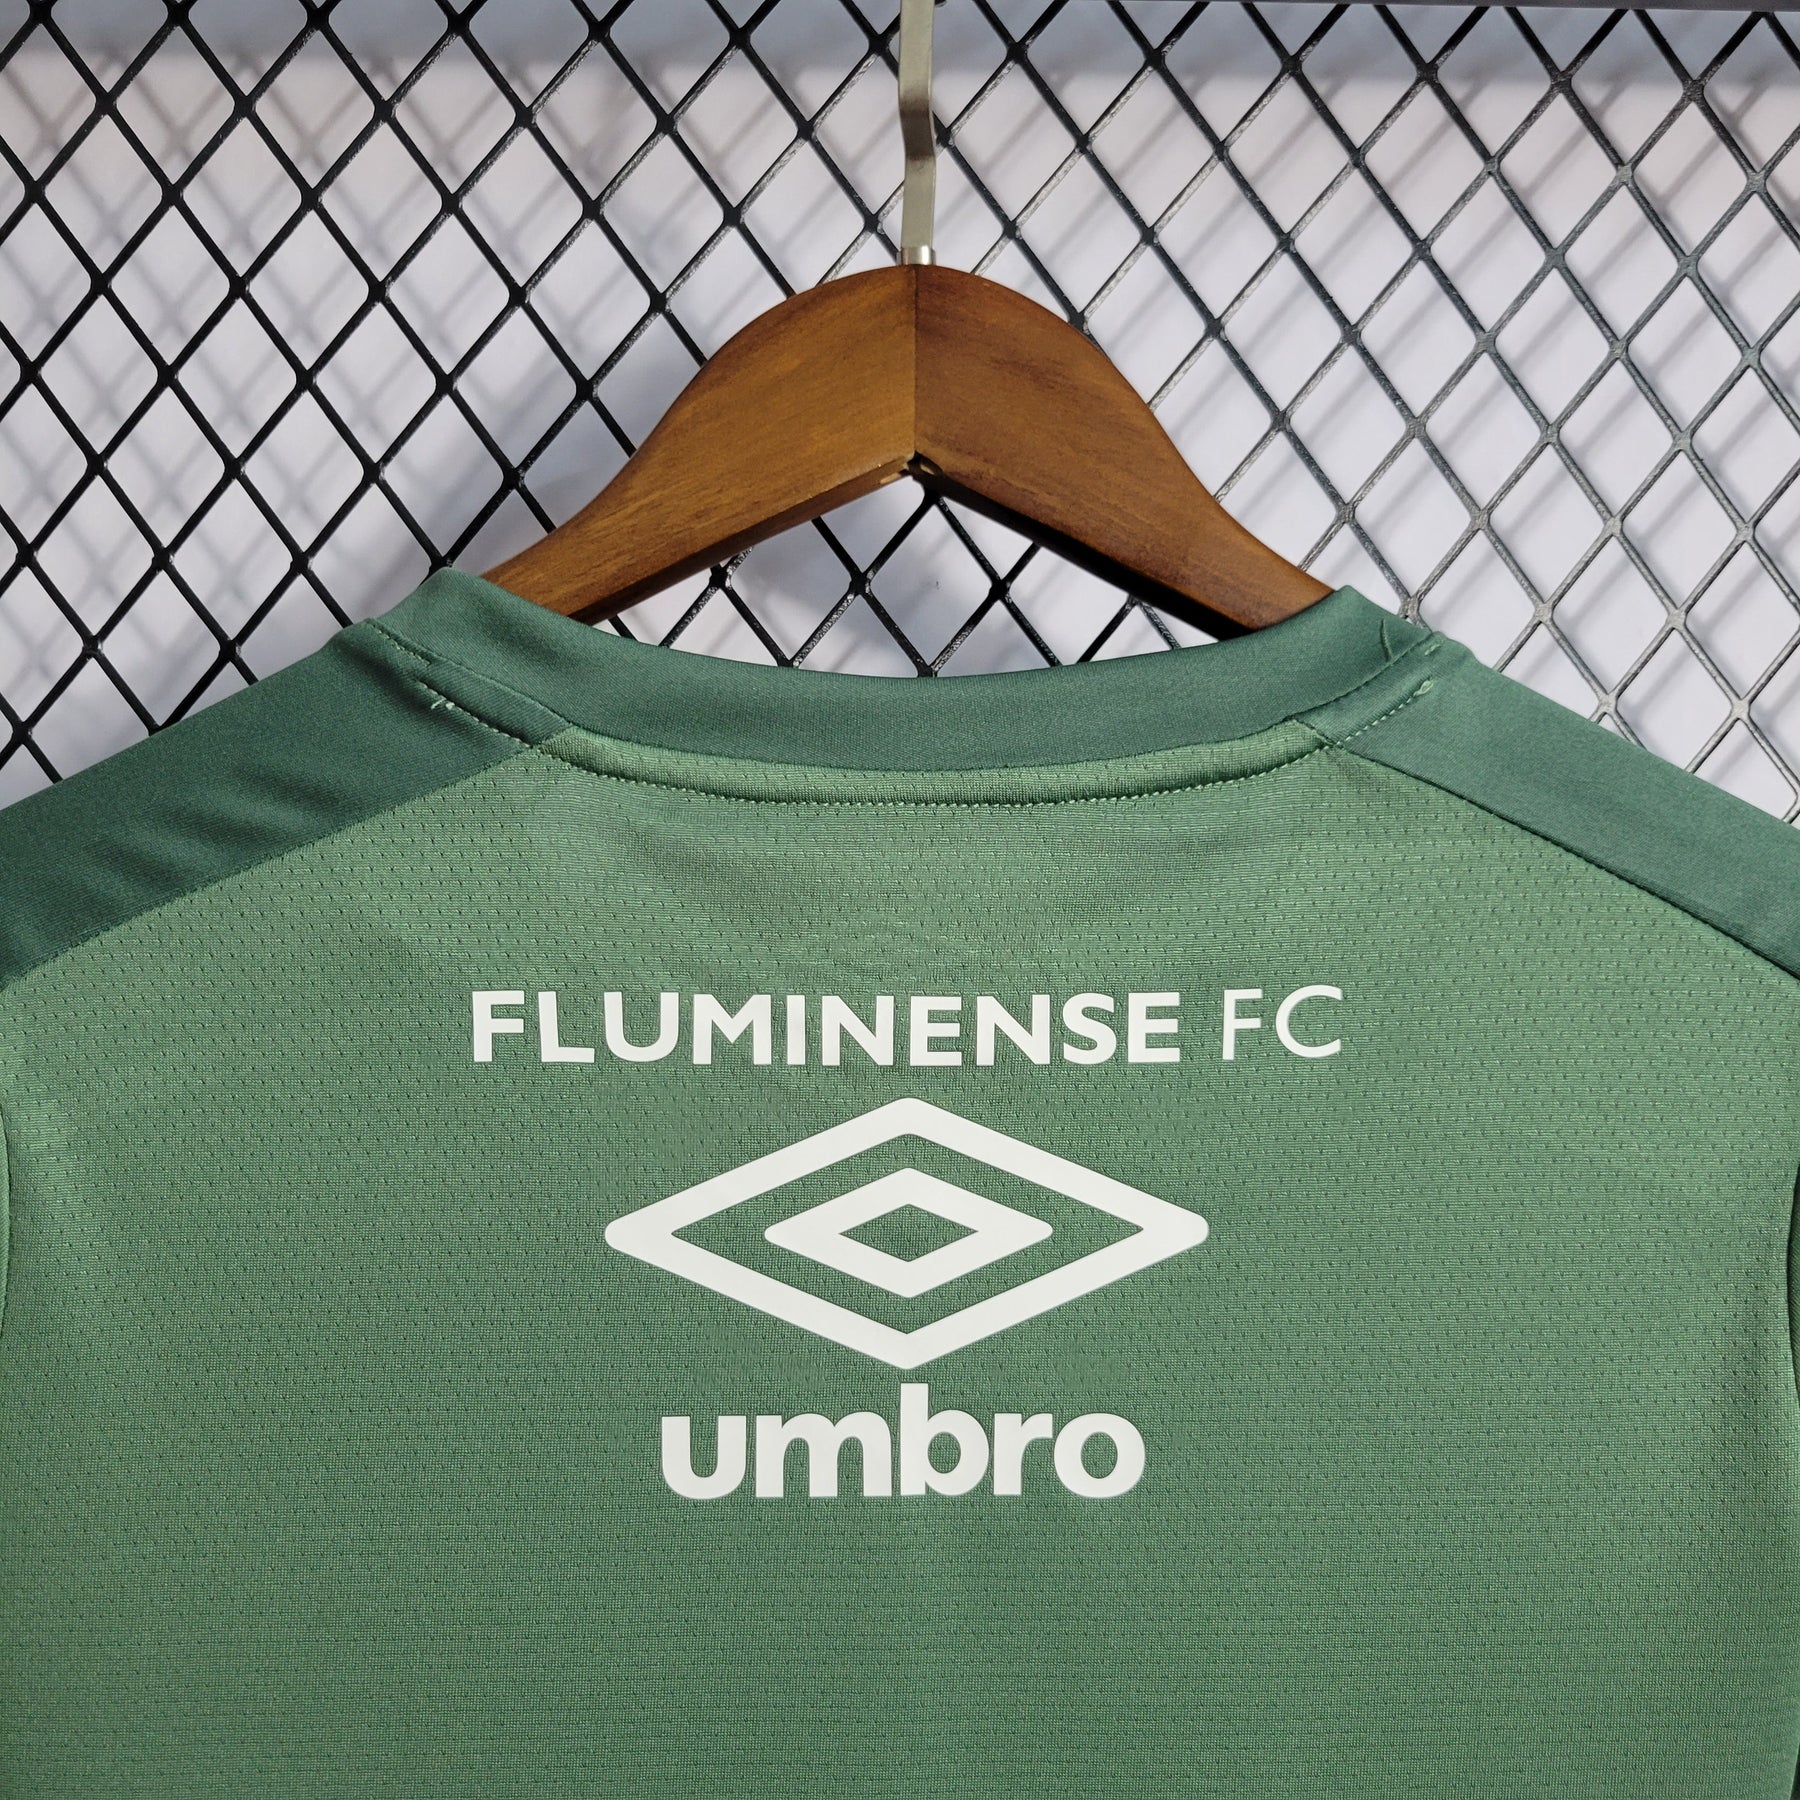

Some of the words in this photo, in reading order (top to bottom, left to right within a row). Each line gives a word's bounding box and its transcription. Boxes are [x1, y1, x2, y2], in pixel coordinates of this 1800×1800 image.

[471, 990, 1181, 1067] FLUMINENSE
[1221, 984, 1343, 1061] FC
[661, 1382, 1146, 1499] umbro
